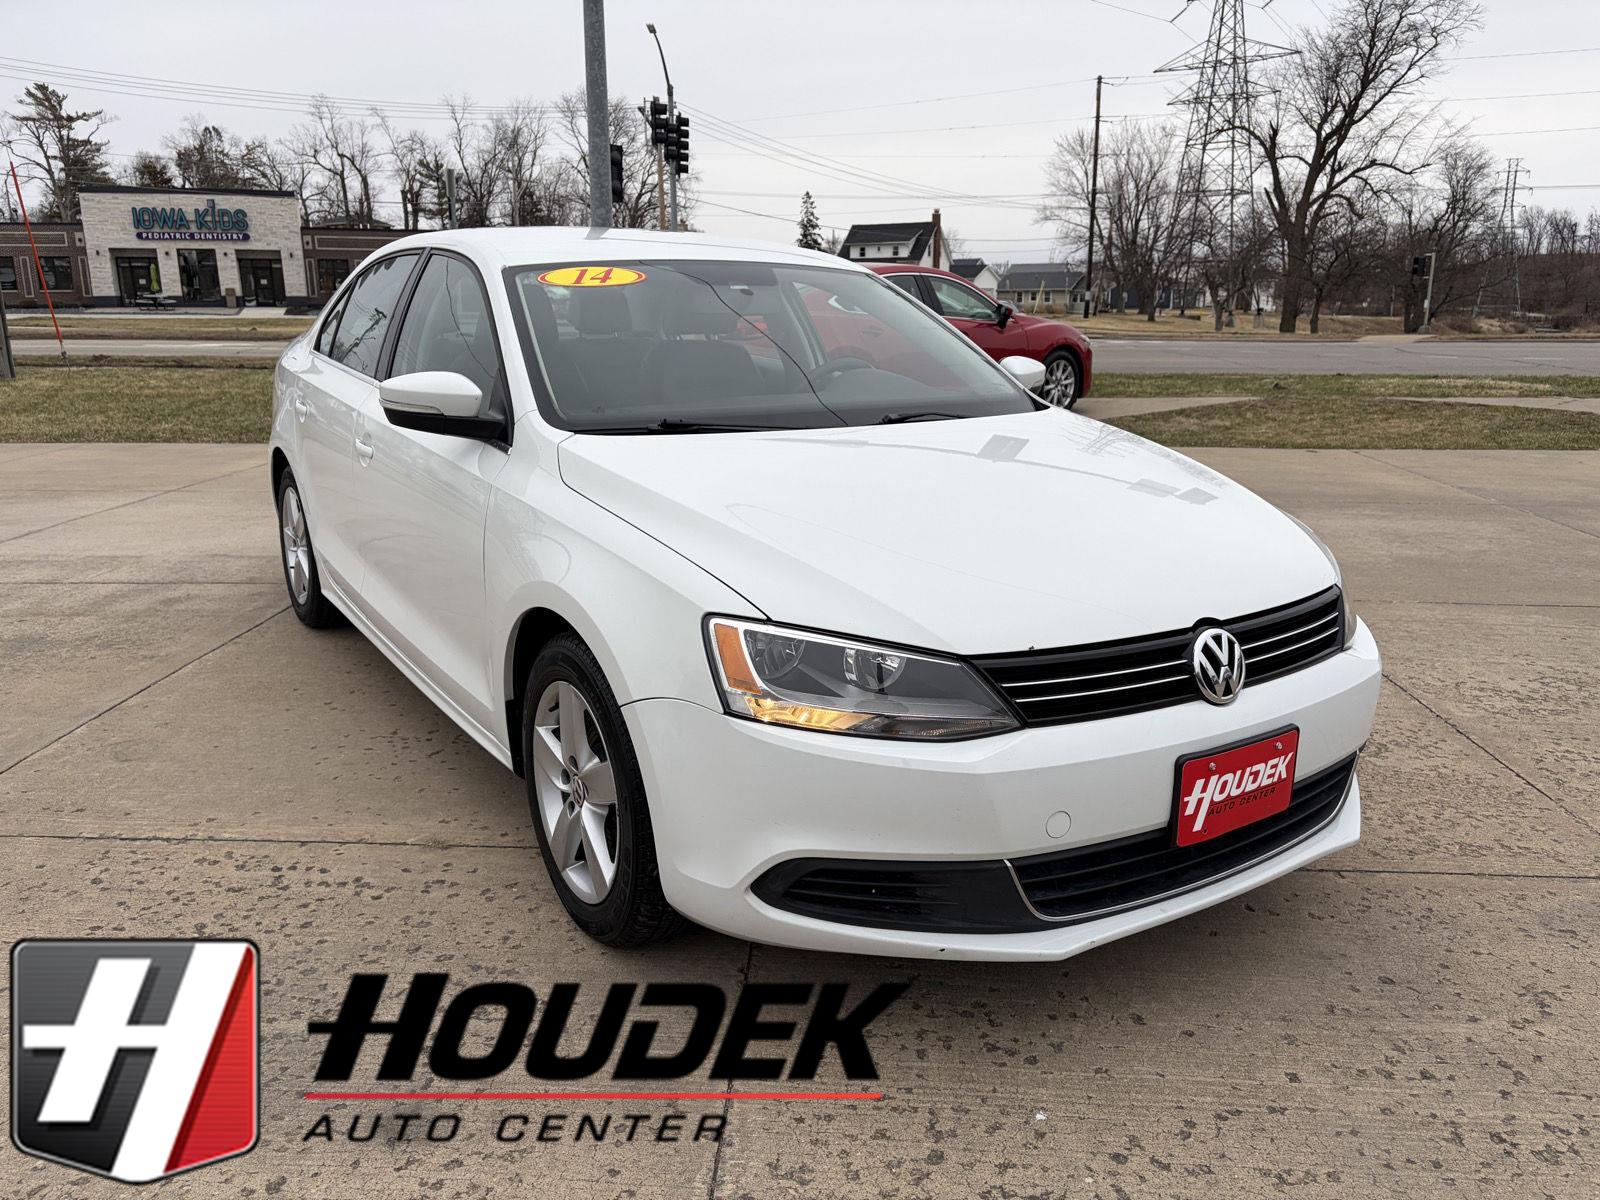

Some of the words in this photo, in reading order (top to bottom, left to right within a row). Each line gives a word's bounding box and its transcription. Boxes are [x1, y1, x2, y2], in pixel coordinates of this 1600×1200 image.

[131, 206, 190, 230] IOWA
[142, 231, 191, 240] PEDIATRIC
[194, 232, 244, 241] DENTISTRY
[572, 267, 614, 285] 14
[1183, 751, 1294, 832] HOUDEK
[1208, 801, 1237, 817] AUTO
[1239, 786, 1277, 806] CENTER
